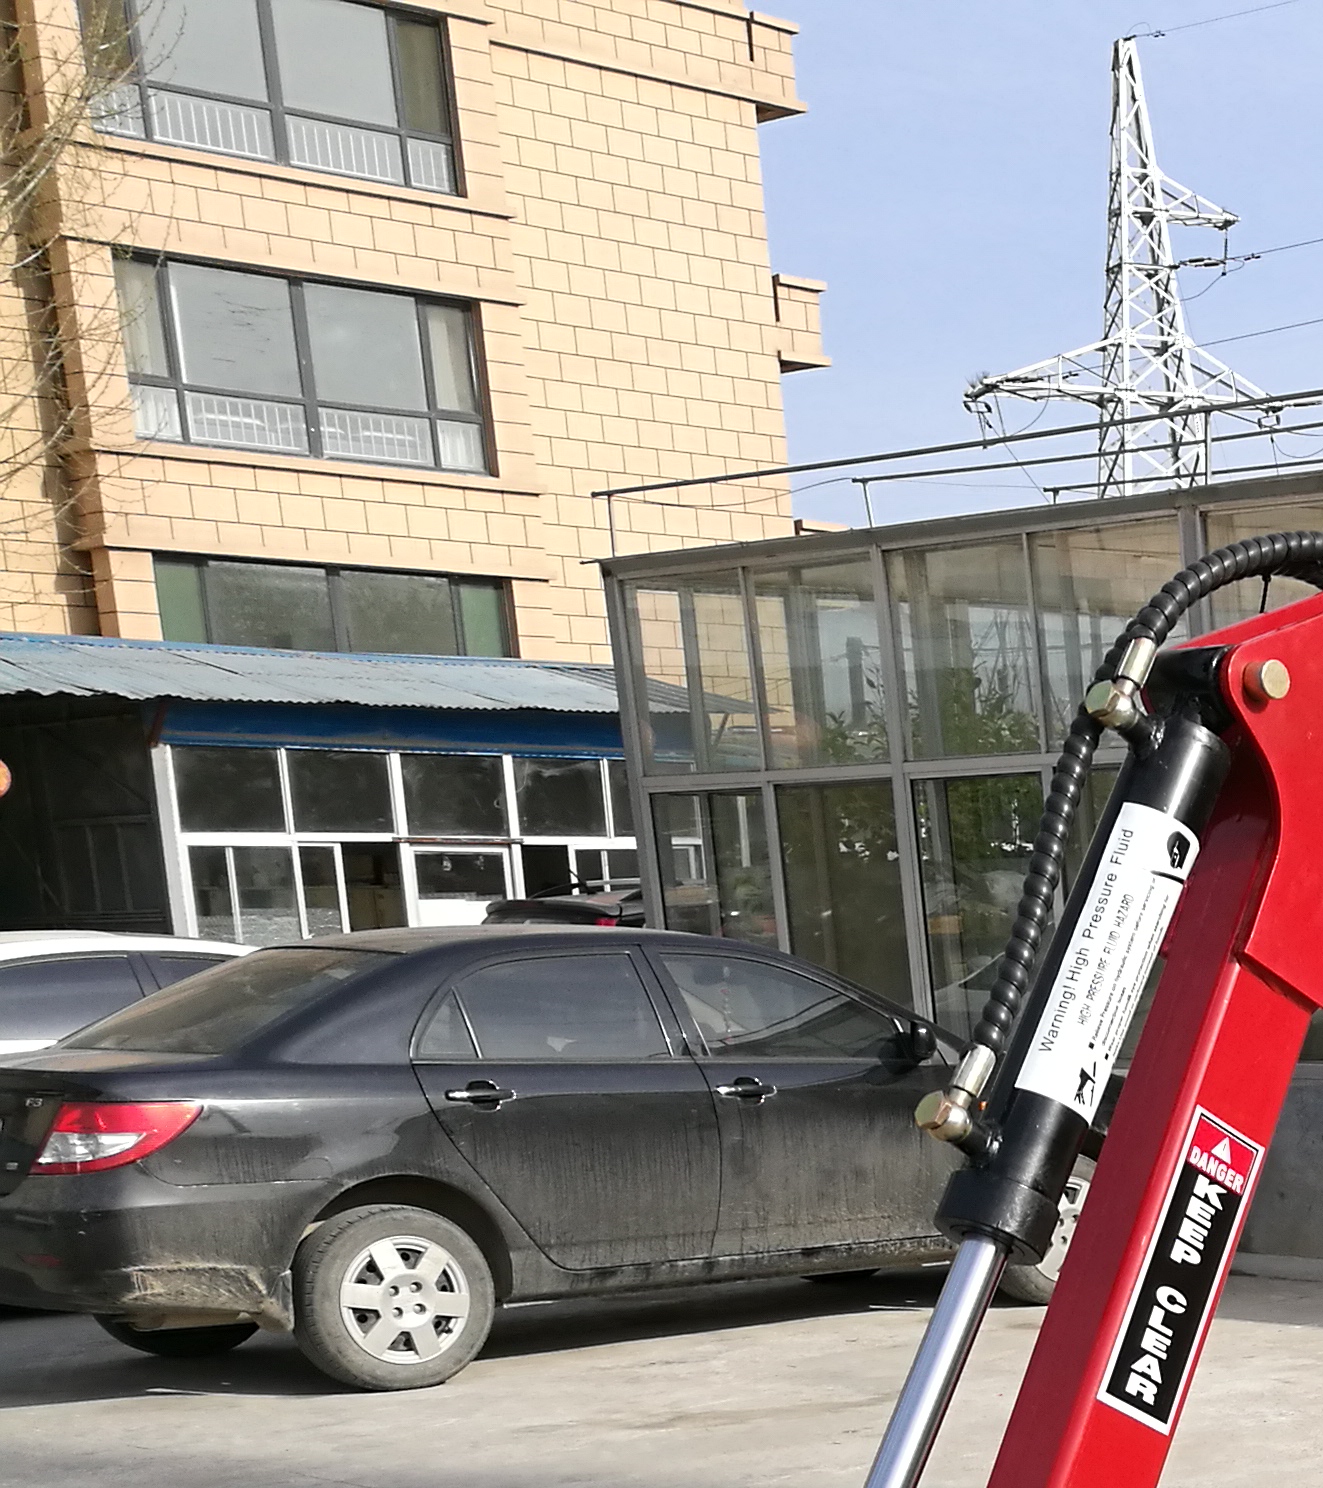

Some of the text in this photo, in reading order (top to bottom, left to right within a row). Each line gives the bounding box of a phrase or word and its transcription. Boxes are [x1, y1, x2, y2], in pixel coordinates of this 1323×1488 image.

[1038, 829, 1133, 1051] Warning! High Pressure Fluid
[1077, 894, 1134, 1025] HIGH PRESSURE FLUID HAZARD
[25, 1097, 44, 1108] F3
[1189, 1146, 1244, 1195] DANGER
[1125, 1174, 1228, 1406] KEEP CLEAR
